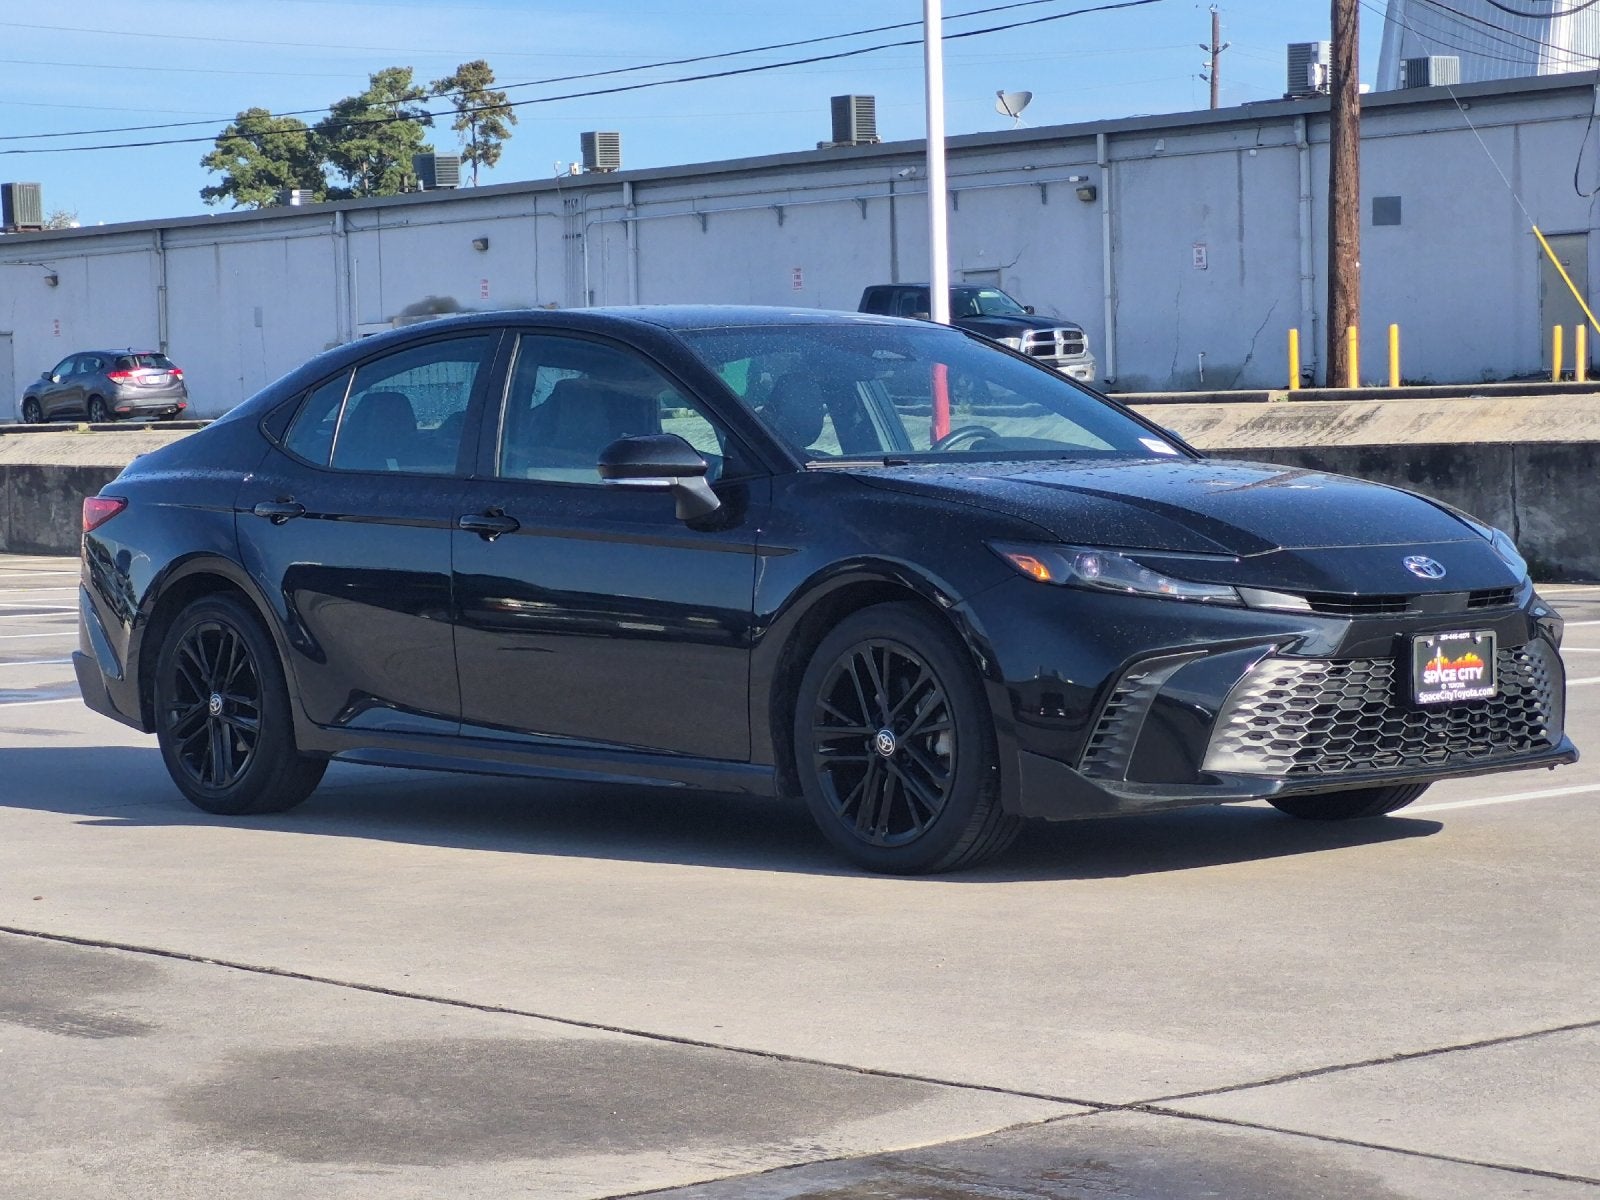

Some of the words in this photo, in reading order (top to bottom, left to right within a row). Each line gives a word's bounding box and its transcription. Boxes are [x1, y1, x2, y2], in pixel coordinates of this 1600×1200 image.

[1423, 668, 1456, 684] SPACE
[1457, 666, 1484, 681] CITY
[1419, 687, 1493, 703] SpaceCityToyota.com
